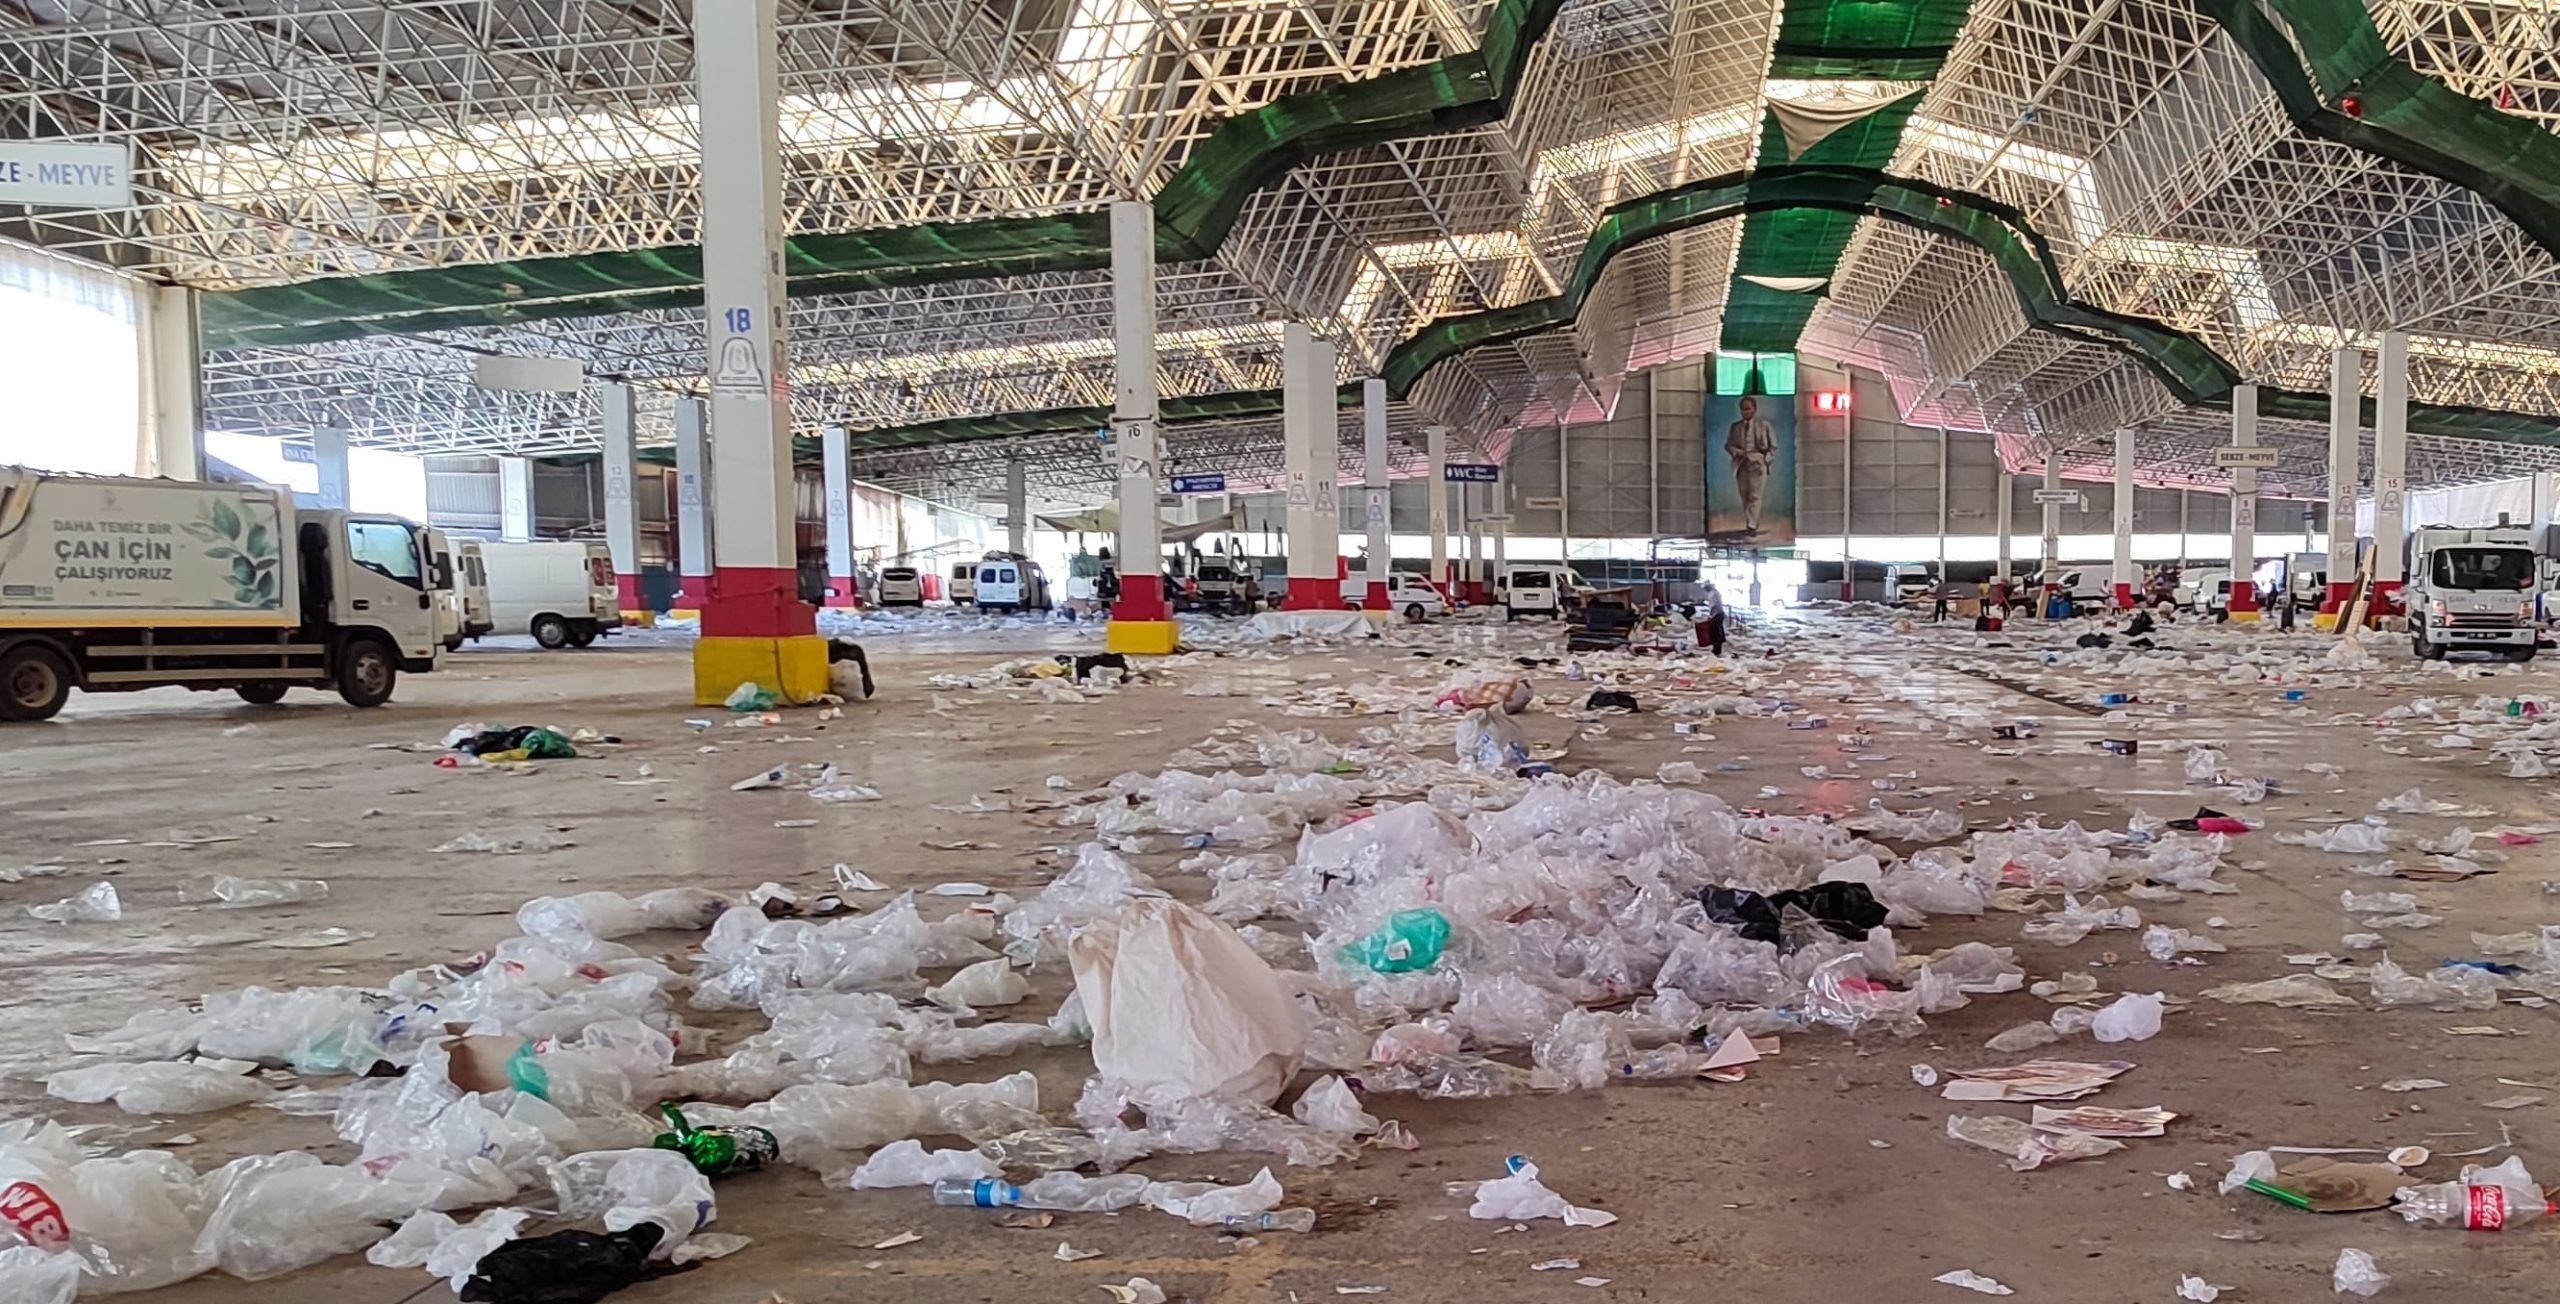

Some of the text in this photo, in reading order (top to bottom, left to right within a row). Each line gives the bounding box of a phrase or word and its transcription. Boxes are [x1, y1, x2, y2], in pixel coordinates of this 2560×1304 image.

[39, 163, 115, 186] MEYVE
[725, 308, 751, 333] 18
[1128, 424, 1140, 438] 16
[1453, 467, 1474, 479] WC
[53, 519, 172, 535] DAHA TEMİZ BİR
[55, 537, 171, 564] ÇAN İÇİN
[55, 567, 173, 582] ÇALIŞIYORUZ
